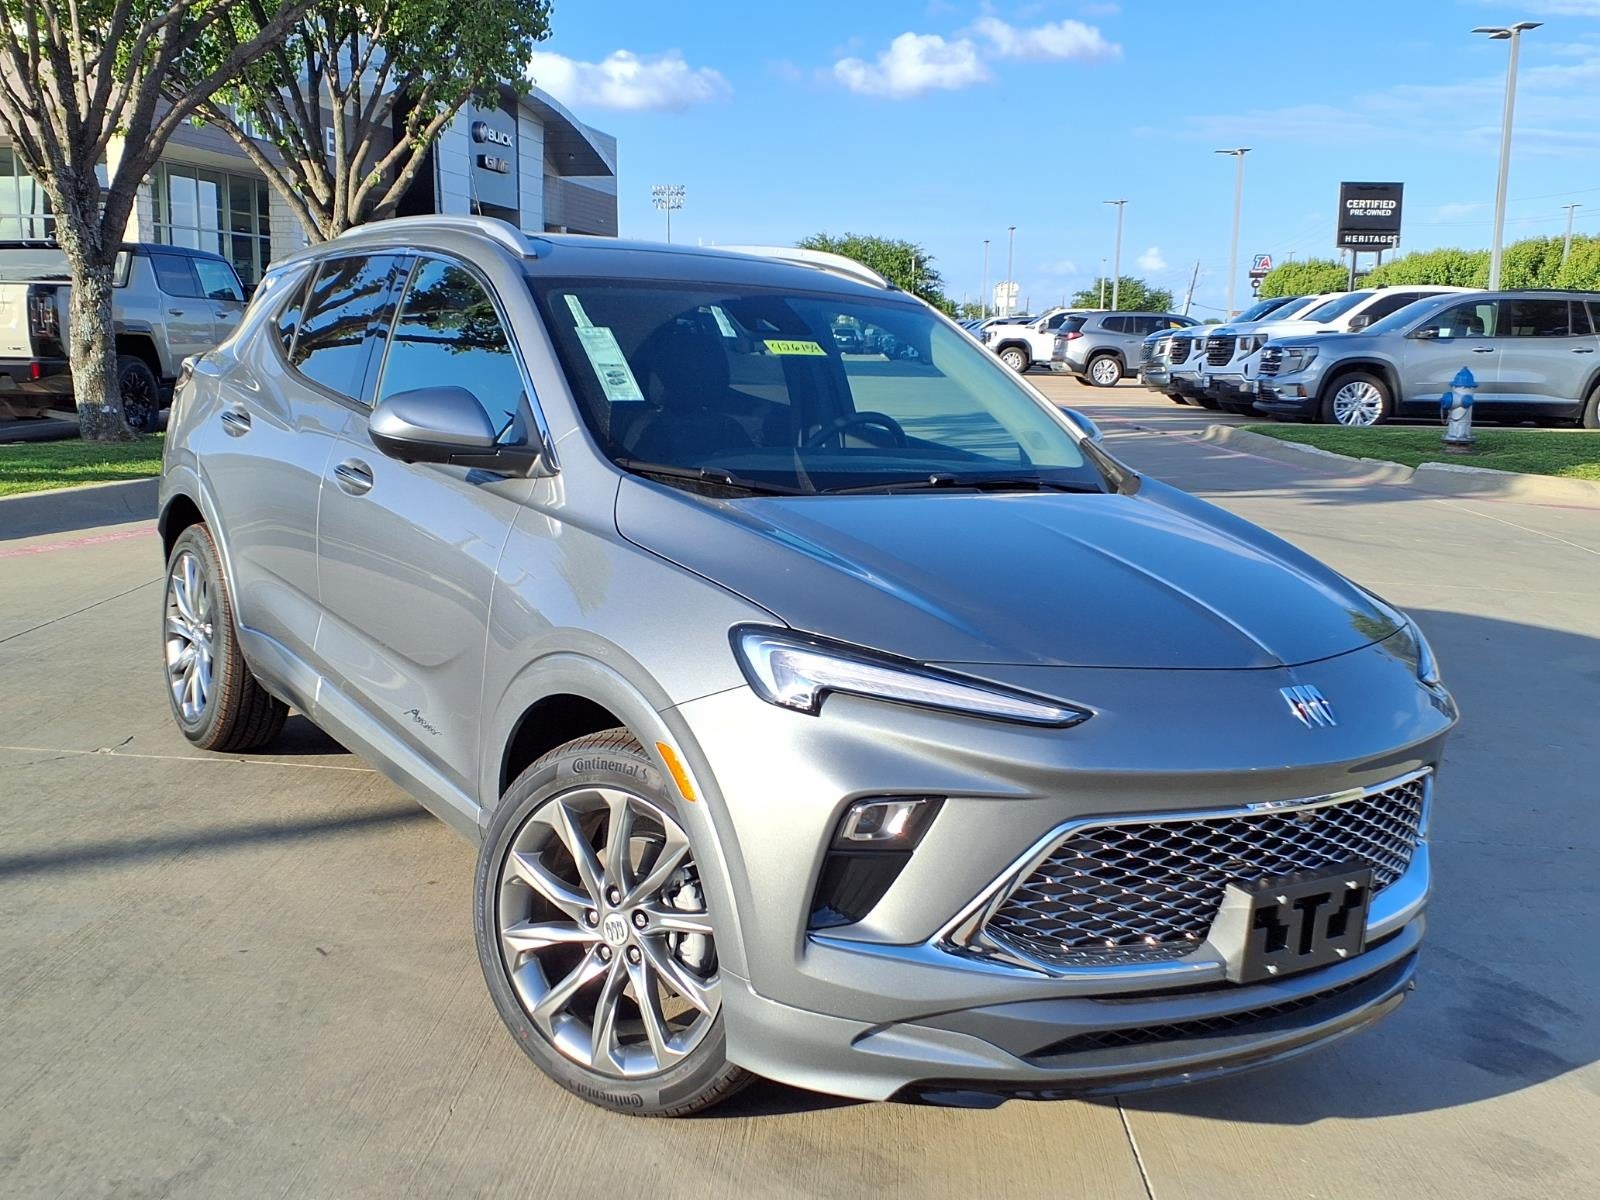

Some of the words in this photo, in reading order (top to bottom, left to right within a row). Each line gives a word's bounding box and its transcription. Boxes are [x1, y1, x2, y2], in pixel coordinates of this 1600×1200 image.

[488, 128, 513, 147] BUICK
[1346, 199, 1397, 209] CERTIFIED
[1344, 234, 1396, 243] HERITAGE
[1254, 255, 1272, 270] TA
[572, 756, 639, 778] Continental
[577, 1083, 644, 1108] Continental
